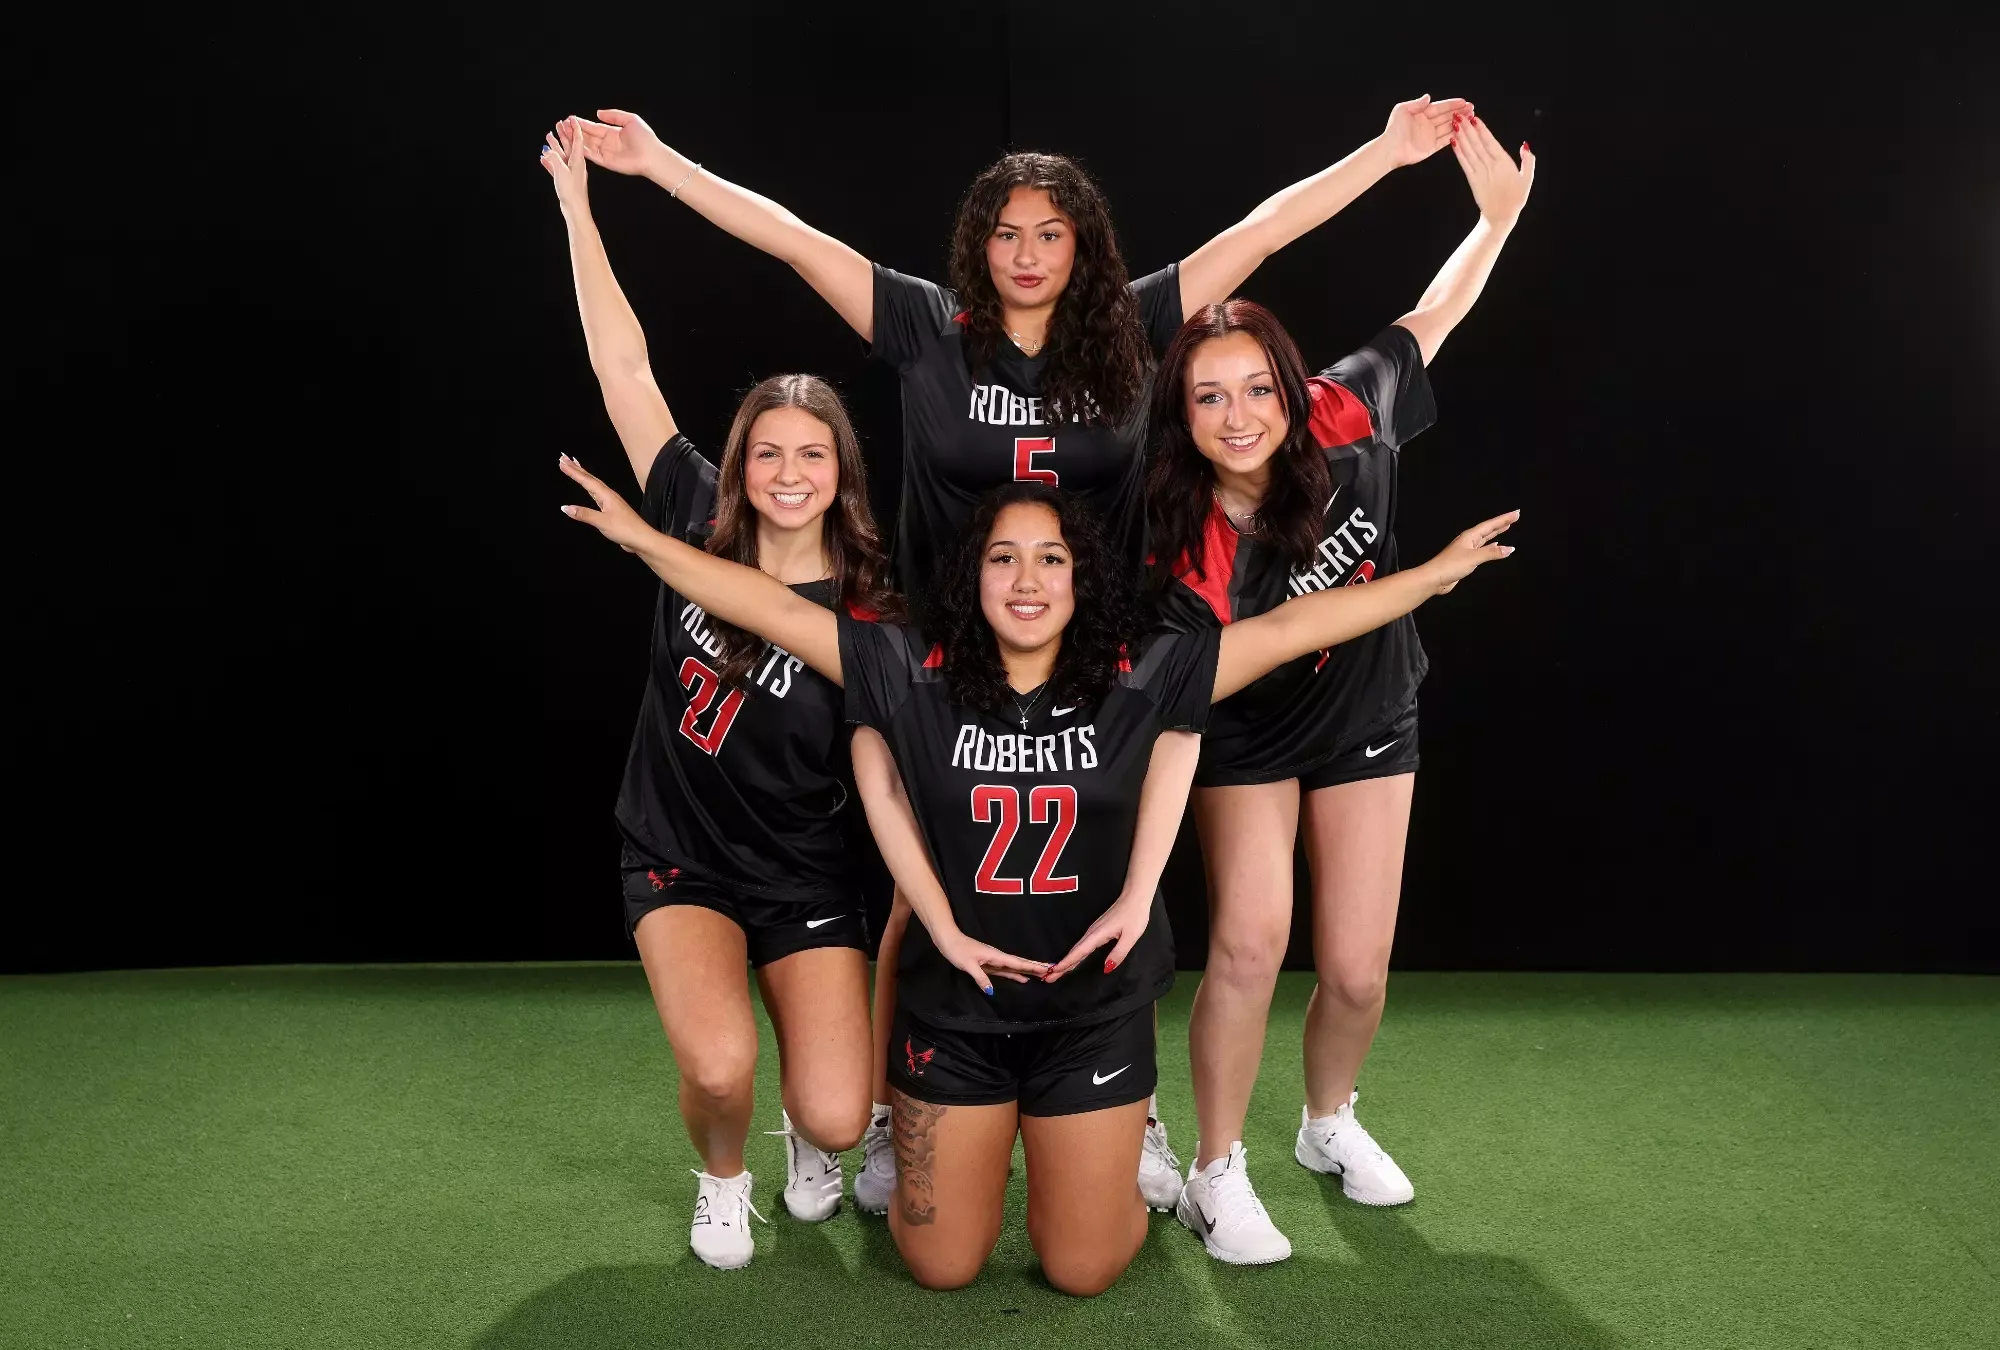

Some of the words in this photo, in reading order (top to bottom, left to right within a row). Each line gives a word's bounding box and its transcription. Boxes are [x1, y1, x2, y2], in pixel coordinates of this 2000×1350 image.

[968, 384, 1101, 426] ROBE
[1286, 506, 1379, 601] BERTS
[678, 656, 745, 757] 21
[951, 723, 1099, 773] ROBERTS
[970, 784, 1079, 895] 22
